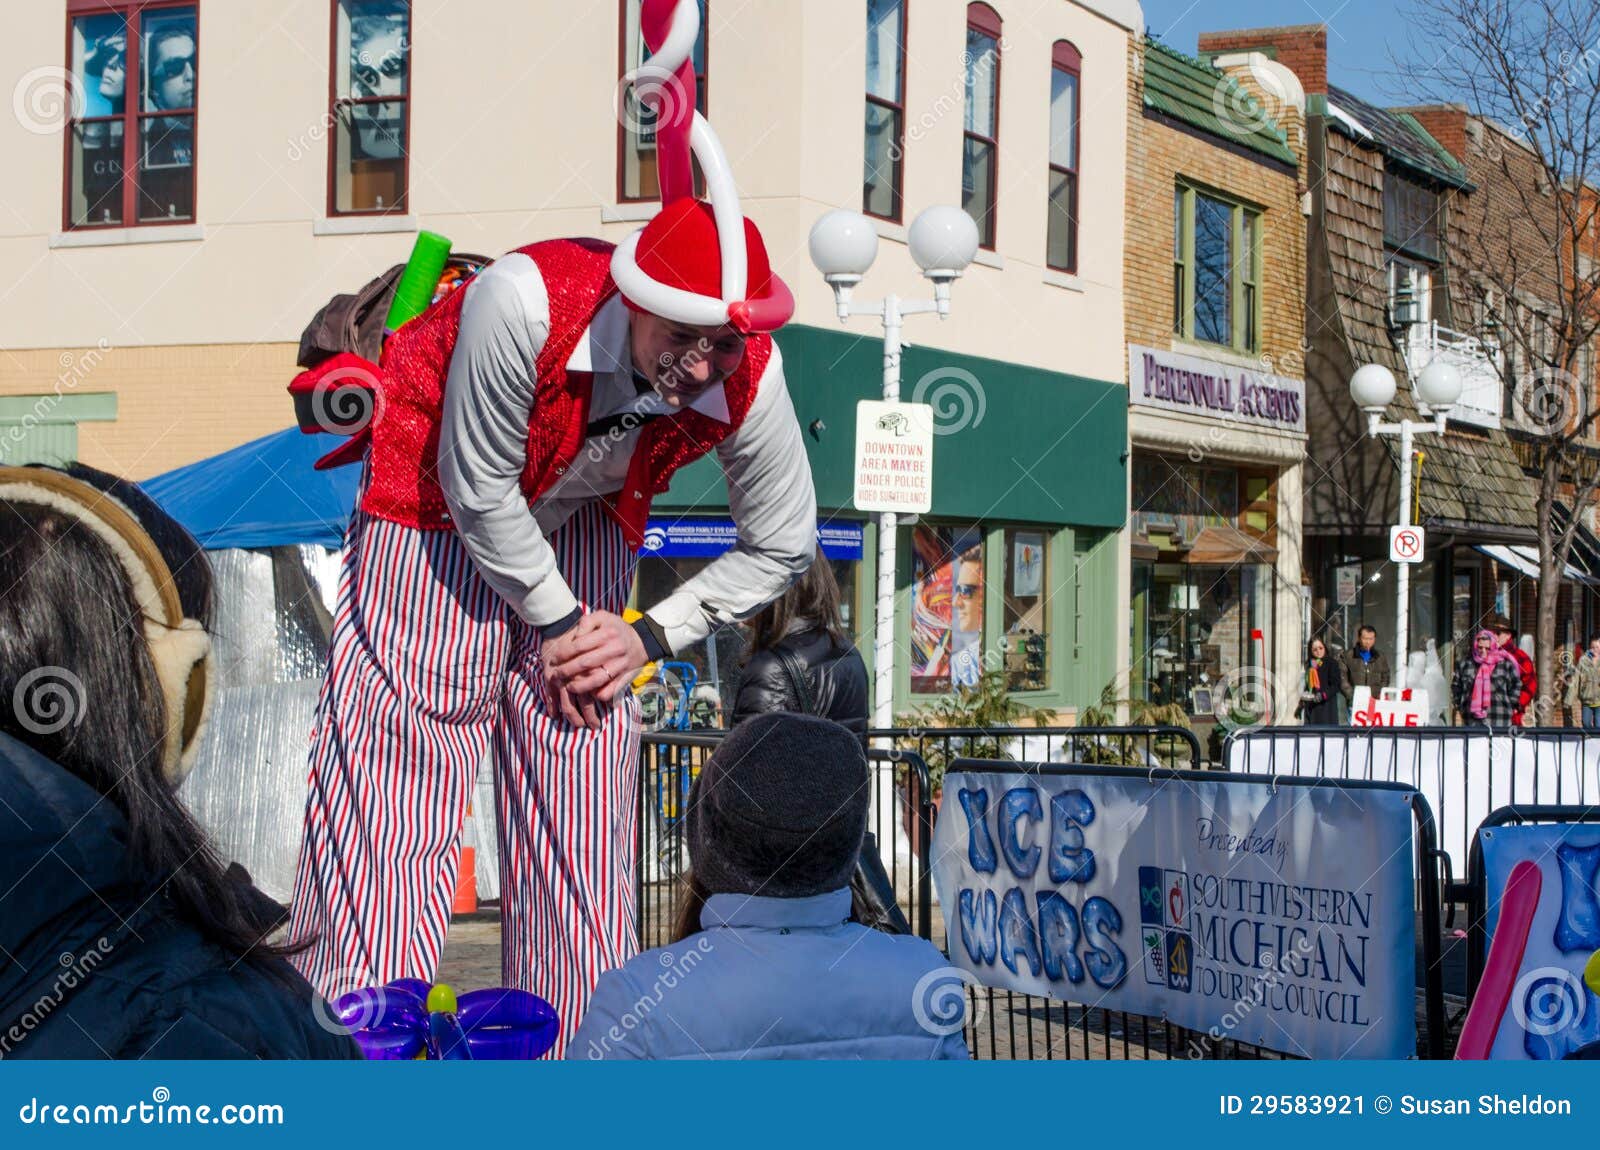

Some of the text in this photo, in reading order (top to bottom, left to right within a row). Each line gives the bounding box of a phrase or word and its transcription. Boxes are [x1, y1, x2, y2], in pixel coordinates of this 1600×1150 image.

[862, 457, 925, 473] AREA MAY BE
[865, 442, 923, 456] DOWNTOWN
[858, 489, 878, 502] VIDEO
[860, 473, 926, 489] UNDER POLICE
[958, 787, 1097, 884] ICE
[959, 886, 1128, 990] WARS
[1194, 912, 1370, 987] MICHIGAN
[1195, 965, 1370, 1026] TOURIST COUNCIL
